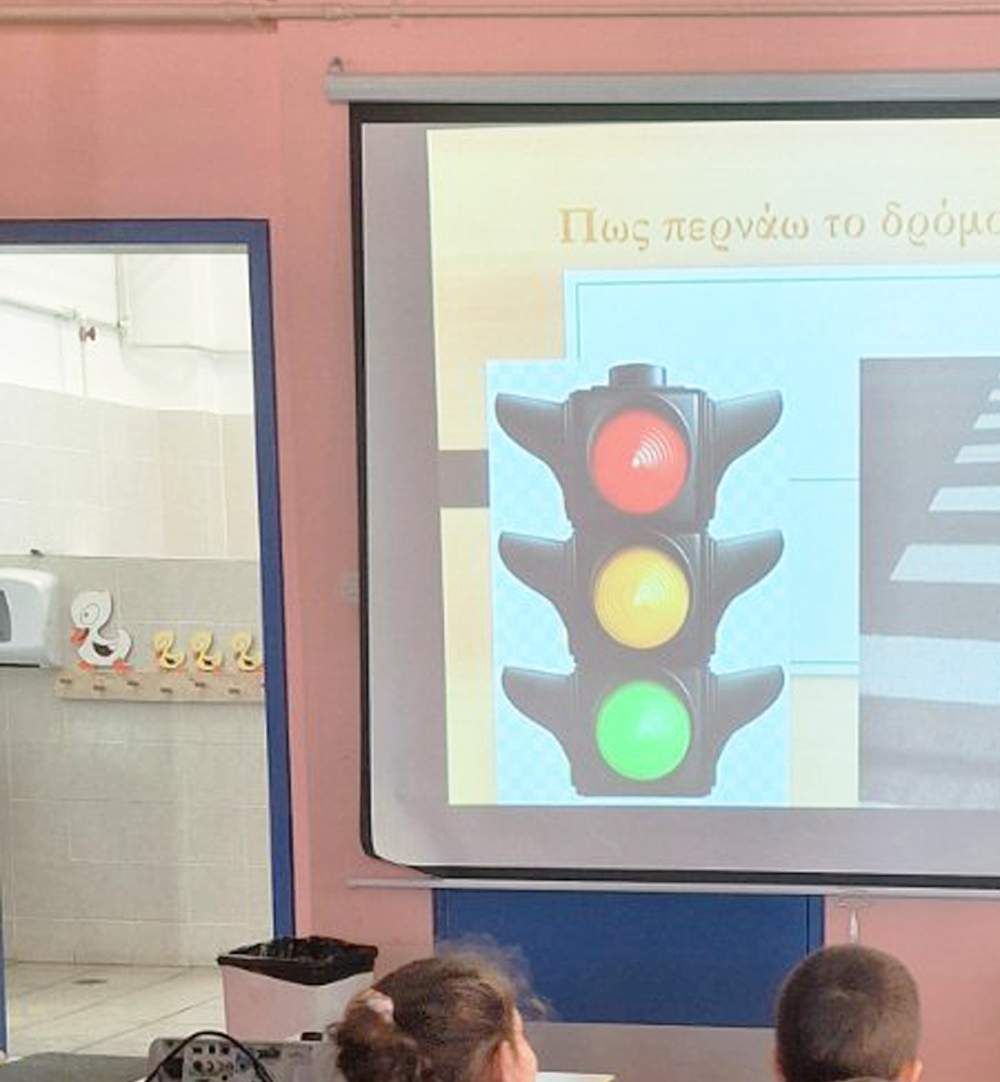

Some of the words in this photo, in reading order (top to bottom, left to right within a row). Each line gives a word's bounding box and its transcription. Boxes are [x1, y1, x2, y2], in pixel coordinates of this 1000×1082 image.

[560, 207, 650, 251] Πως
[663, 202, 810, 252] περνάω
[824, 212, 866, 240] το
